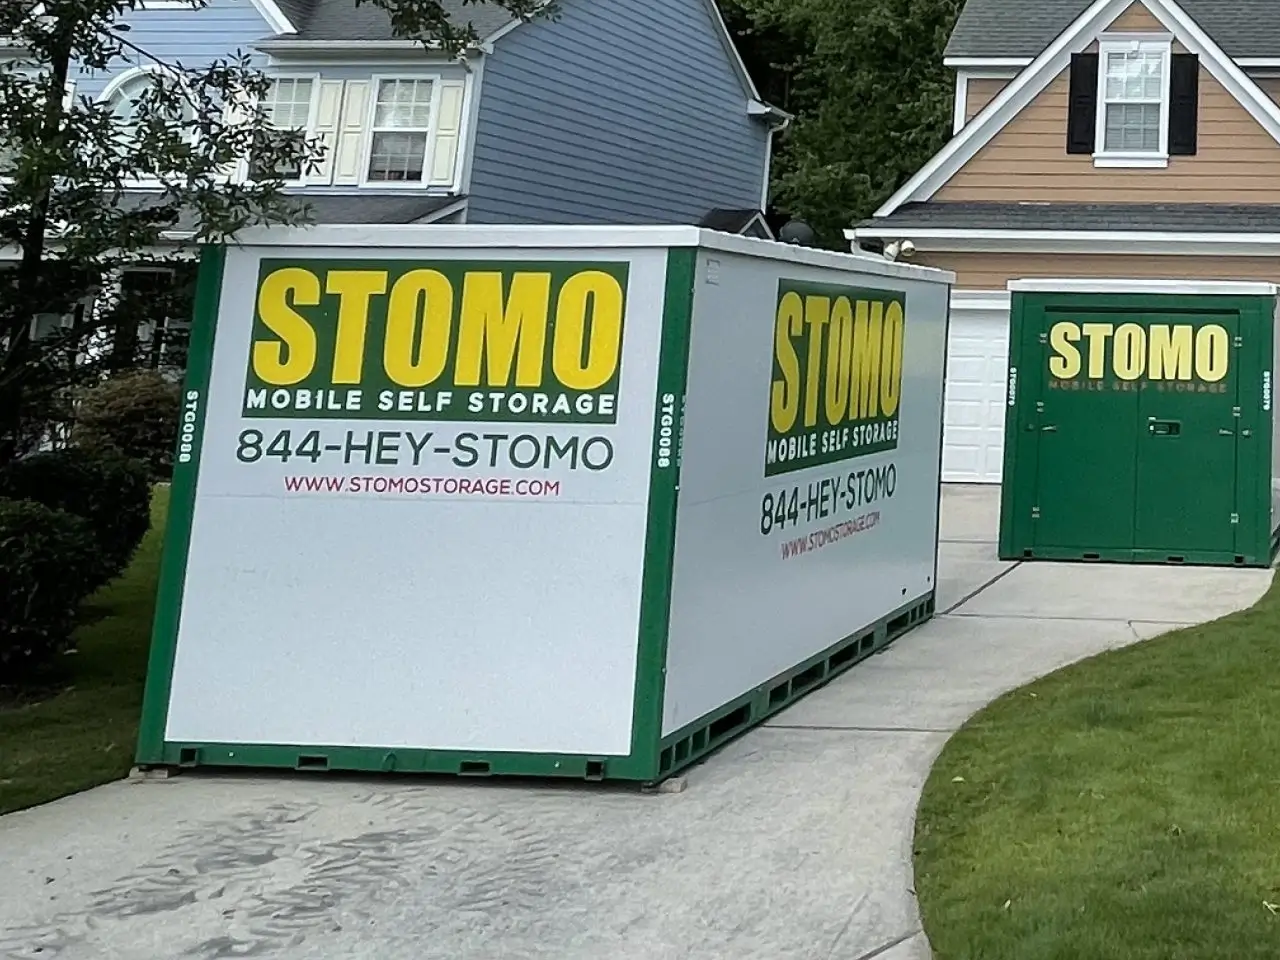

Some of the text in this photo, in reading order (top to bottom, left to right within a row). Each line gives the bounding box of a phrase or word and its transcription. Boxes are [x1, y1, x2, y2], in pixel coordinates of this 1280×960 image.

[252, 267, 623, 390] STOMO
[1049, 321, 1229, 382] STOMO
[771, 291, 903, 433] STOMO
[178, 389, 199, 464] STG0088
[246, 387, 616, 416] MOBILE SELF STORAGE
[657, 392, 675, 469] STG0088
[236, 428, 615, 471] 844-HEY-STOMO
[767, 420, 898, 462] MOBILE SELF STORAGE
[284, 476, 560, 497] WWW.STOMOSTORAGE.COM
[761, 463, 897, 536] 844-HEY-STOMO
[781, 511, 881, 560] WWW.STOMOSTORAGE.COM
